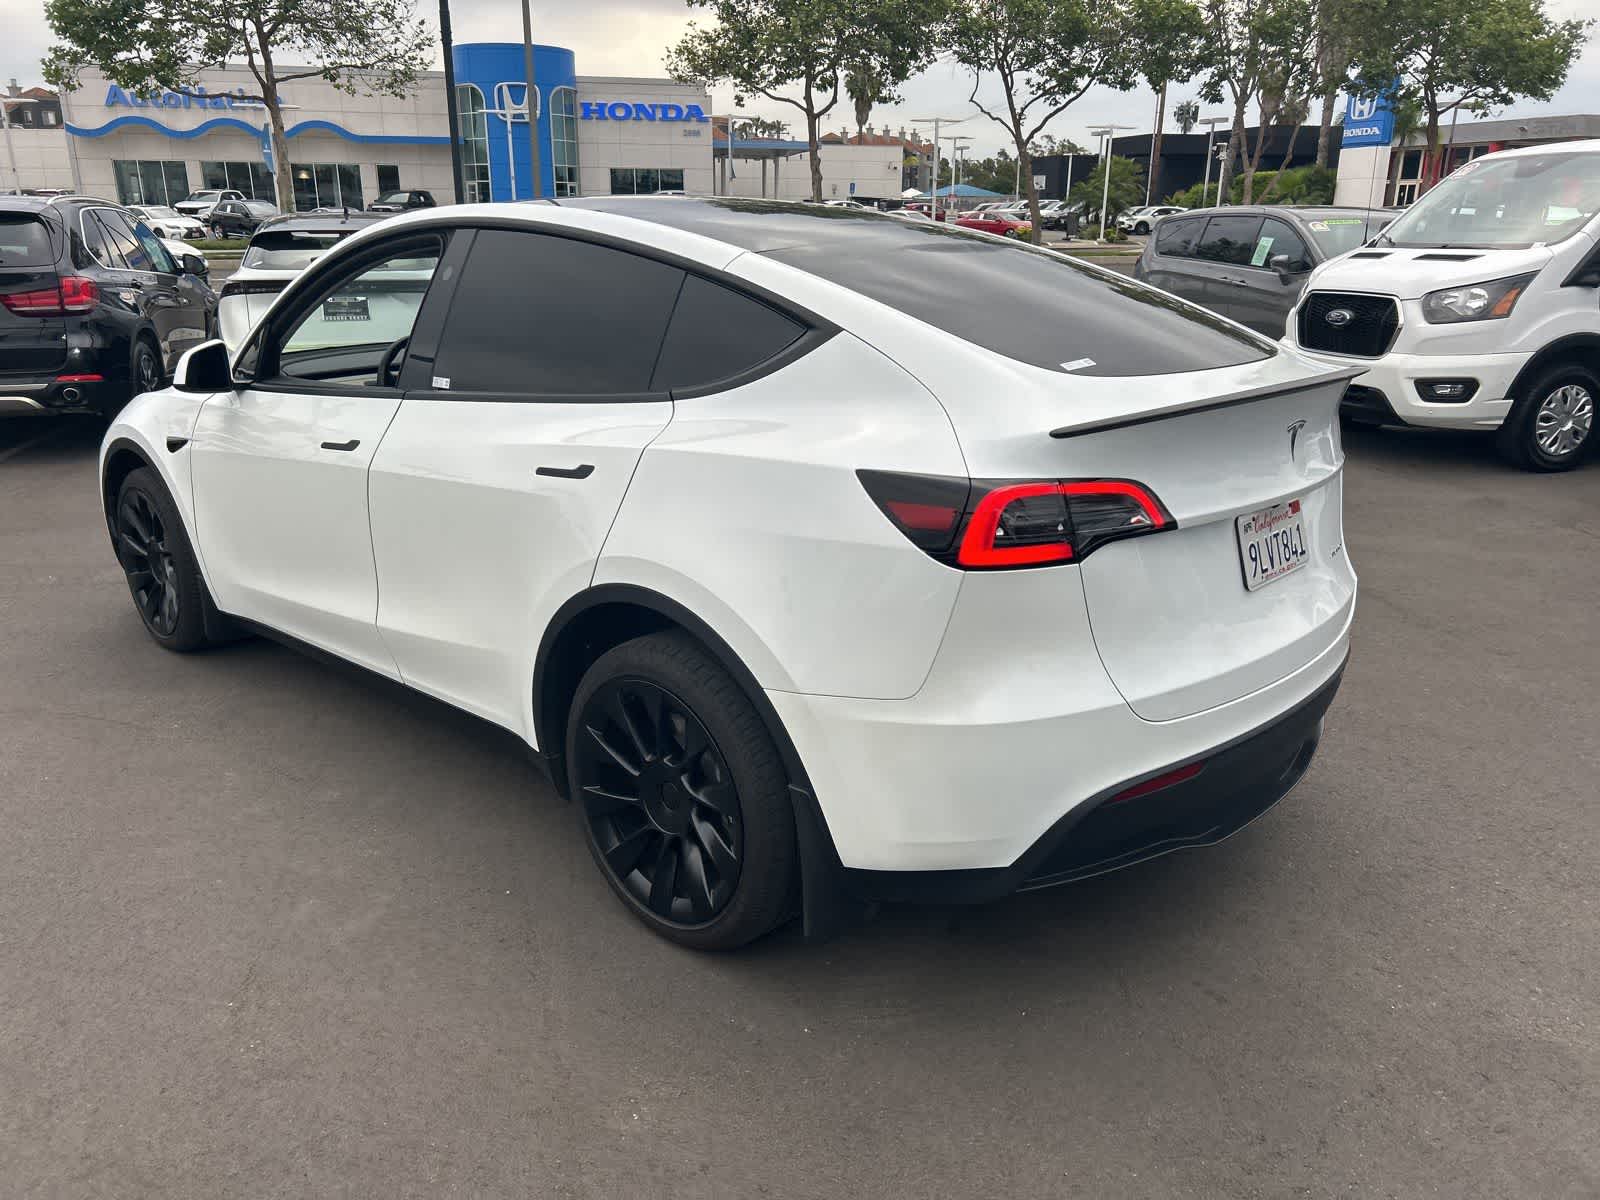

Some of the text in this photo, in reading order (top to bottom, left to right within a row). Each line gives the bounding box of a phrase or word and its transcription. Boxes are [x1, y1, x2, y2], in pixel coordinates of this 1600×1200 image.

[580, 101, 709, 122] HONDA
[1344, 126, 1381, 137] HONDA
[1249, 523, 1305, 578] 9LVT841
